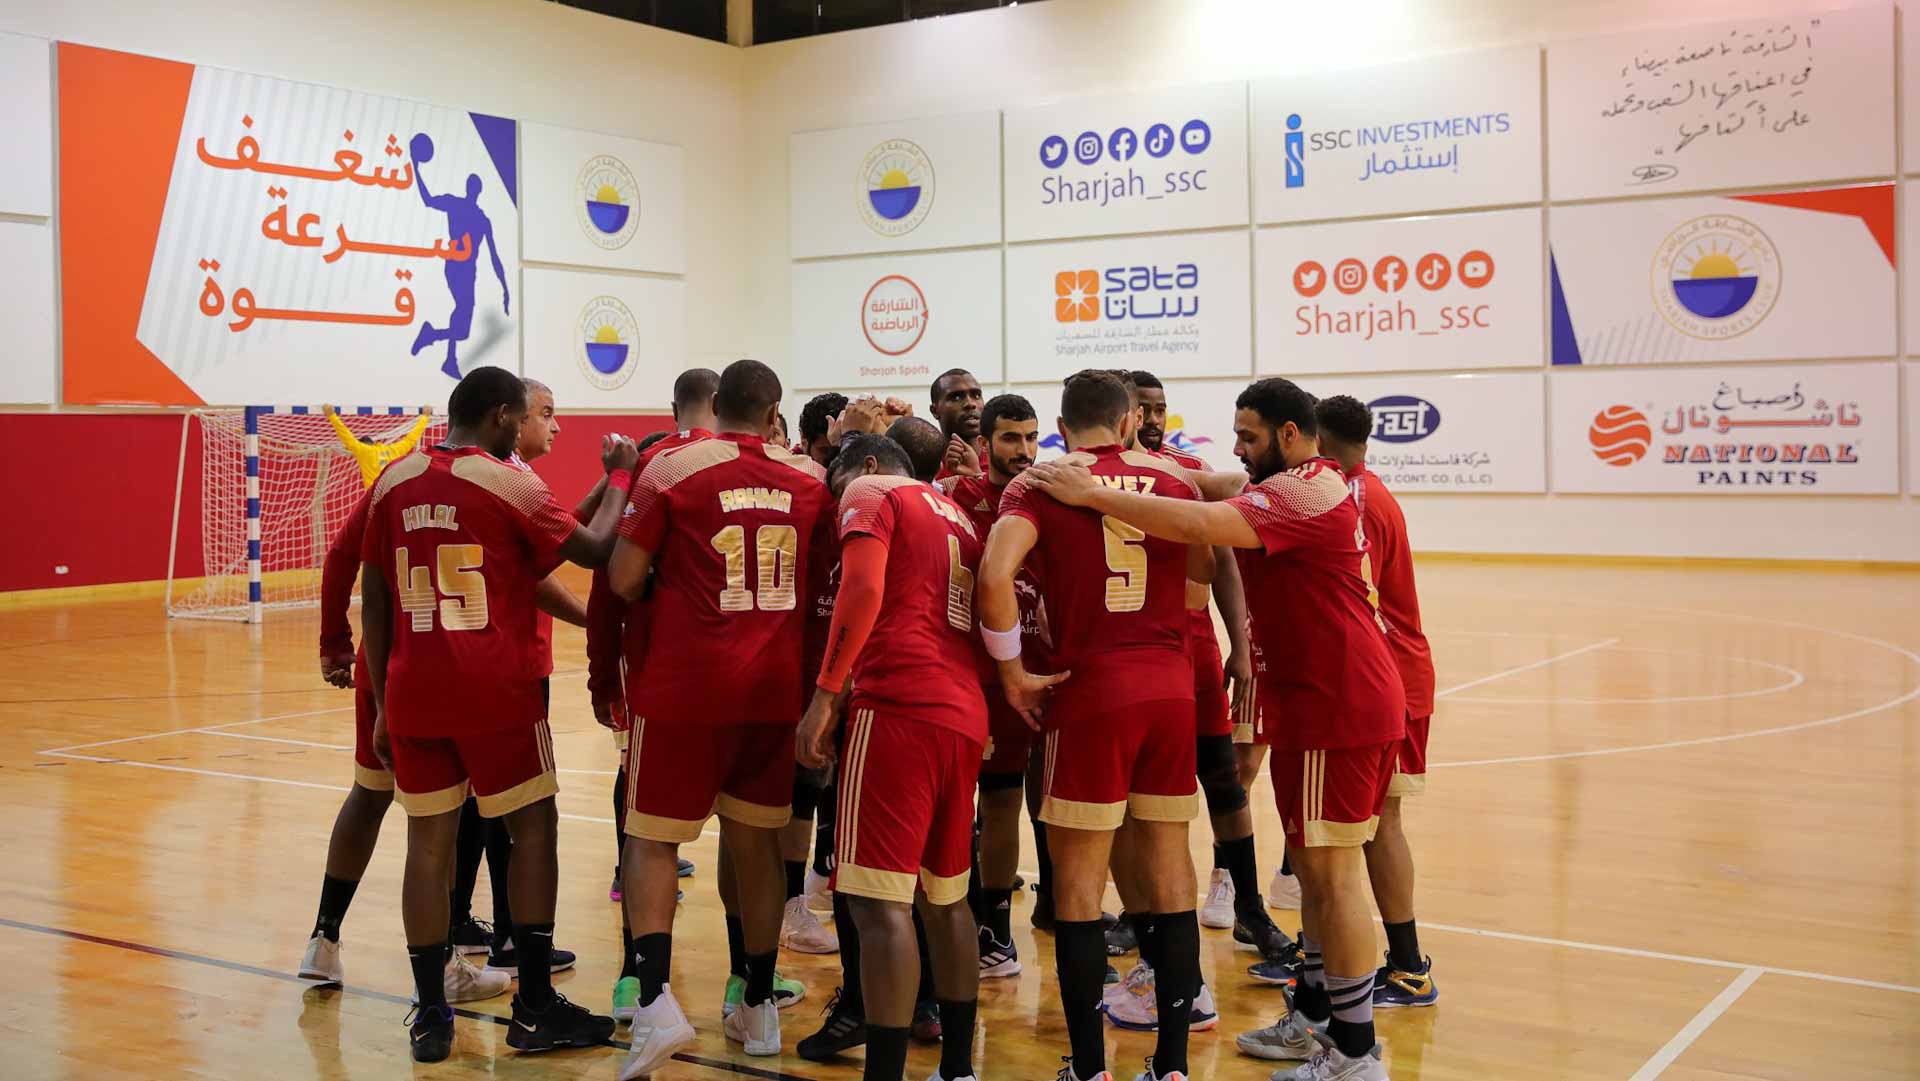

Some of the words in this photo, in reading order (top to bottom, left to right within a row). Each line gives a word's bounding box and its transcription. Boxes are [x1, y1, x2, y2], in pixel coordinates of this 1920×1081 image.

[1790, 57, 1812, 97] في
[1310, 130, 1352, 151] SSC
[1357, 112, 1510, 147] INVESTMENTS
[197, 115, 413, 190] شغف
[1359, 144, 1458, 182] إستثمار
[1041, 168, 1208, 207] Sharjah_ssc
[261, 185, 472, 263] سرعة
[198, 258, 415, 332] قوة
[872, 297, 918, 314] الشارقة
[1105, 294, 1198, 320] ساتا
[872, 315, 918, 333] الرياضية
[1295, 300, 1489, 341] Sharjah_ssc
[1056, 344, 1091, 357] Sharjah
[1094, 343, 1127, 354] Airport
[1130, 342, 1159, 352] Travel
[1161, 341, 1199, 353] Agency
[1661, 399, 1861, 434] ناشونال
[1662, 443, 1858, 463] NATIONAL
[1698, 470, 1817, 485] PAINTS
[402, 504, 459, 532] HILAL
[719, 487, 793, 514] RAHMA
[711, 525, 797, 611] 10
[1102, 515, 1147, 612] 5
[396, 544, 489, 632] 45
